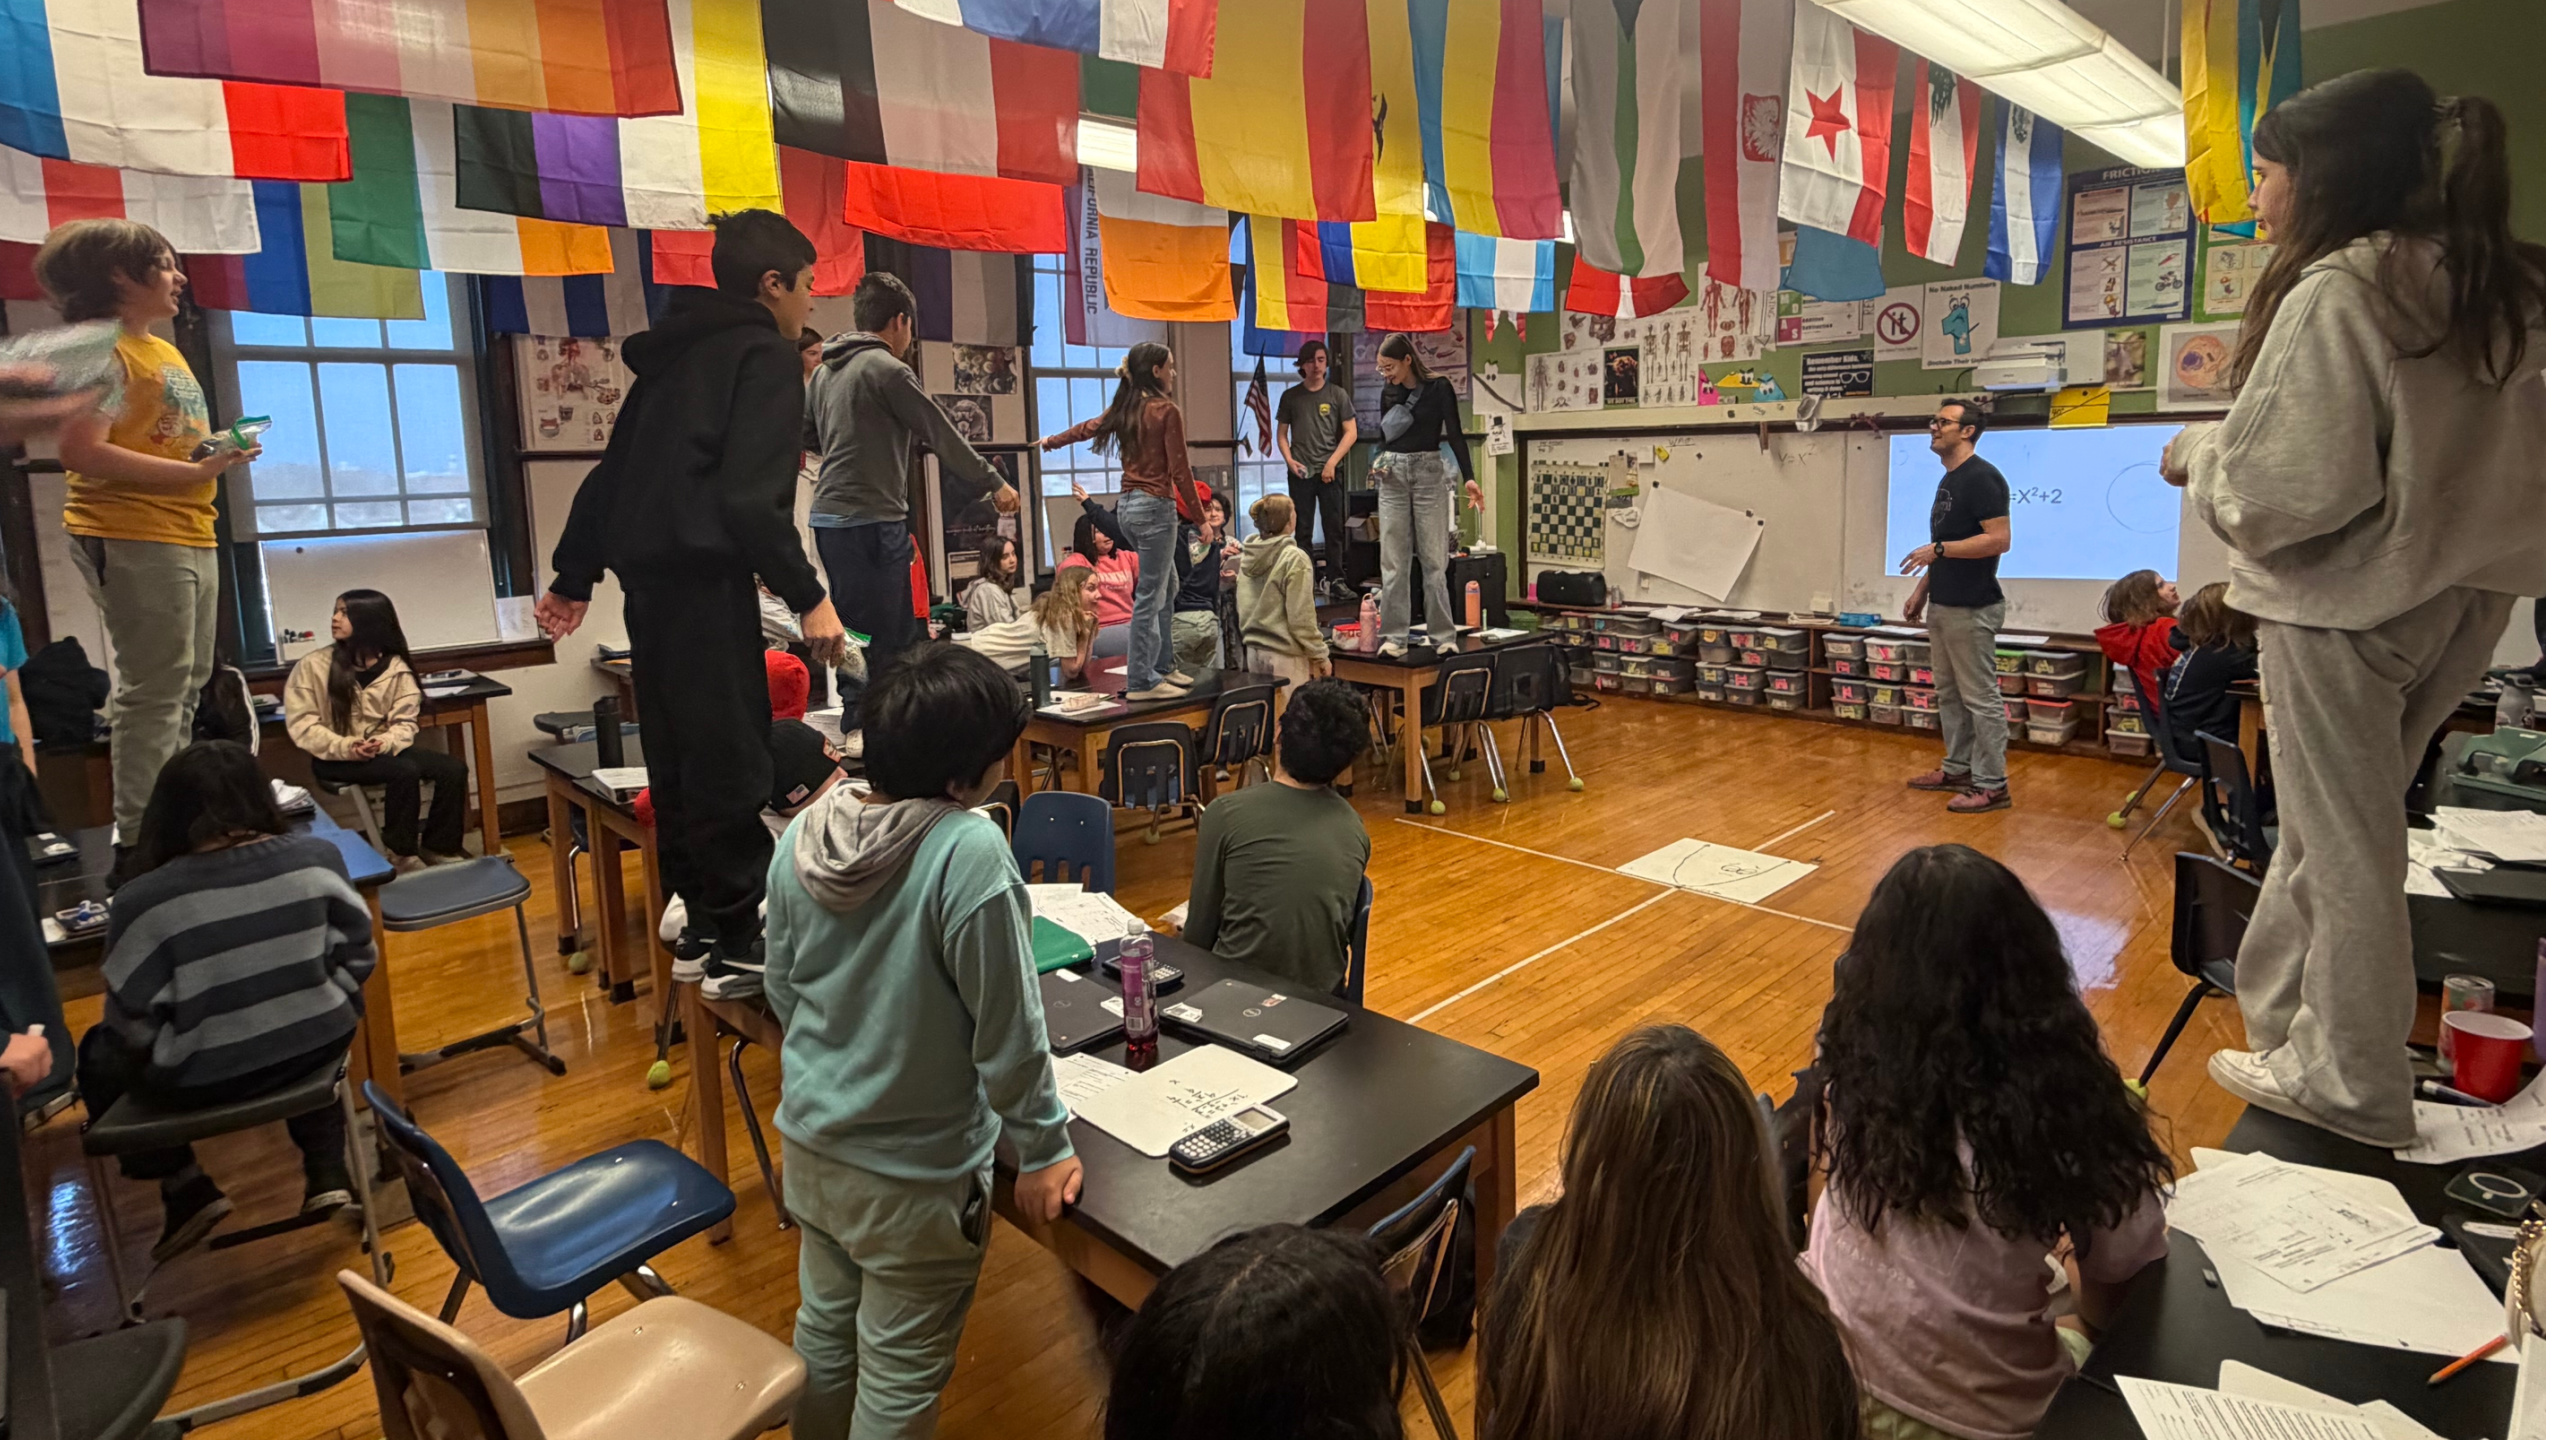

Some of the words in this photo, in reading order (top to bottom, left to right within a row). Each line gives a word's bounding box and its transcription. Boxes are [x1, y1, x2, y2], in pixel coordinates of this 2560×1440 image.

[1084, 247, 1098, 315] REPUBLIC
[1940, 284, 1963, 292] Naked
[1963, 282, 1997, 290] Numbers
[1780, 319, 1789, 331] A
[1890, 311, 1907, 336] it
[1791, 328, 1799, 339] S
